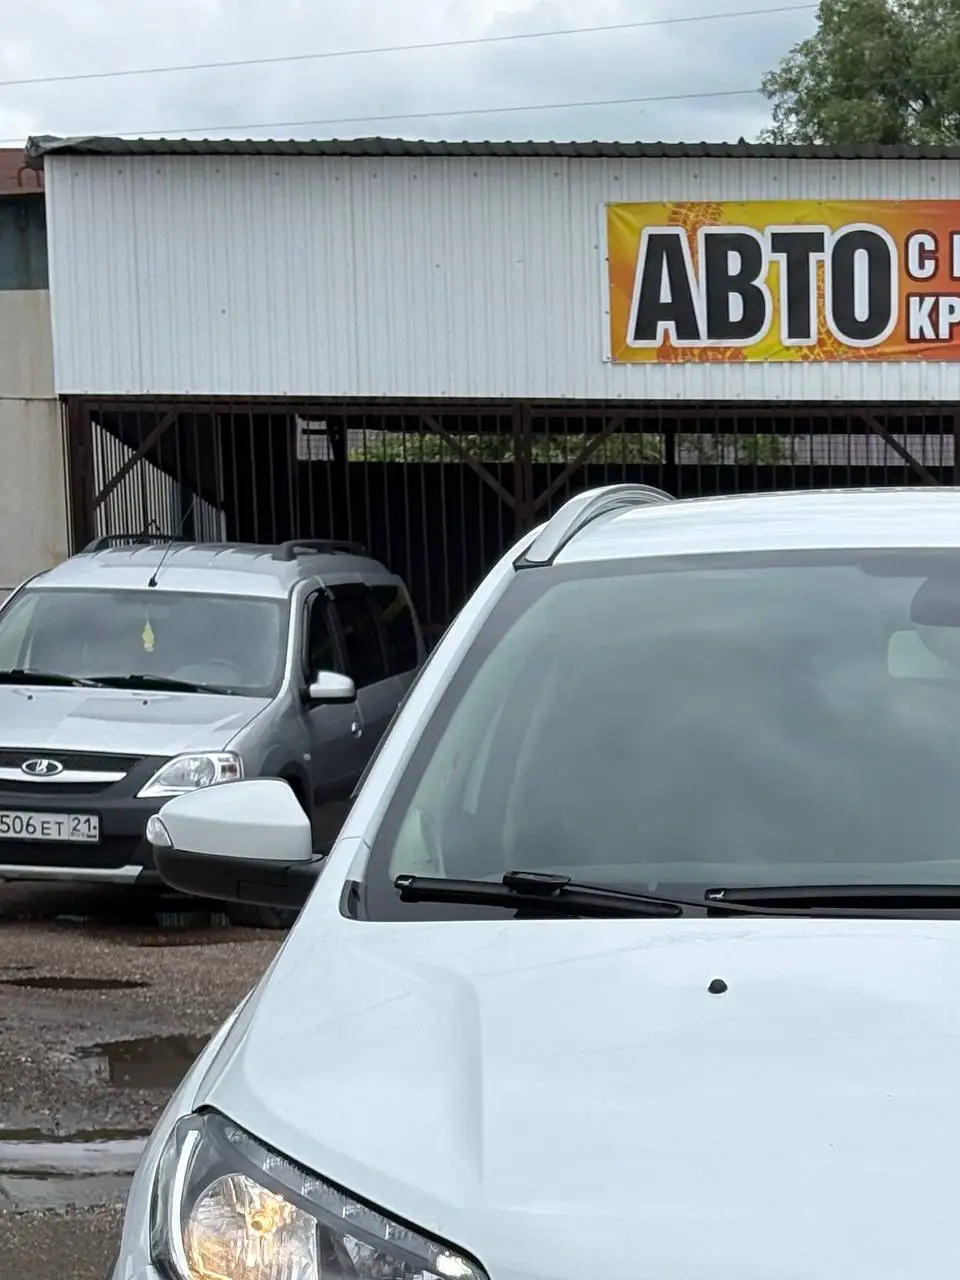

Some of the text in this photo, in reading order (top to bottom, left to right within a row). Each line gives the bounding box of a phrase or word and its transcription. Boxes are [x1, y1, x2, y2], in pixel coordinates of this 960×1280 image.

[907, 233, 937, 280] С
[631, 228, 896, 345] АВТО
[71, 816, 92, 833] 21
